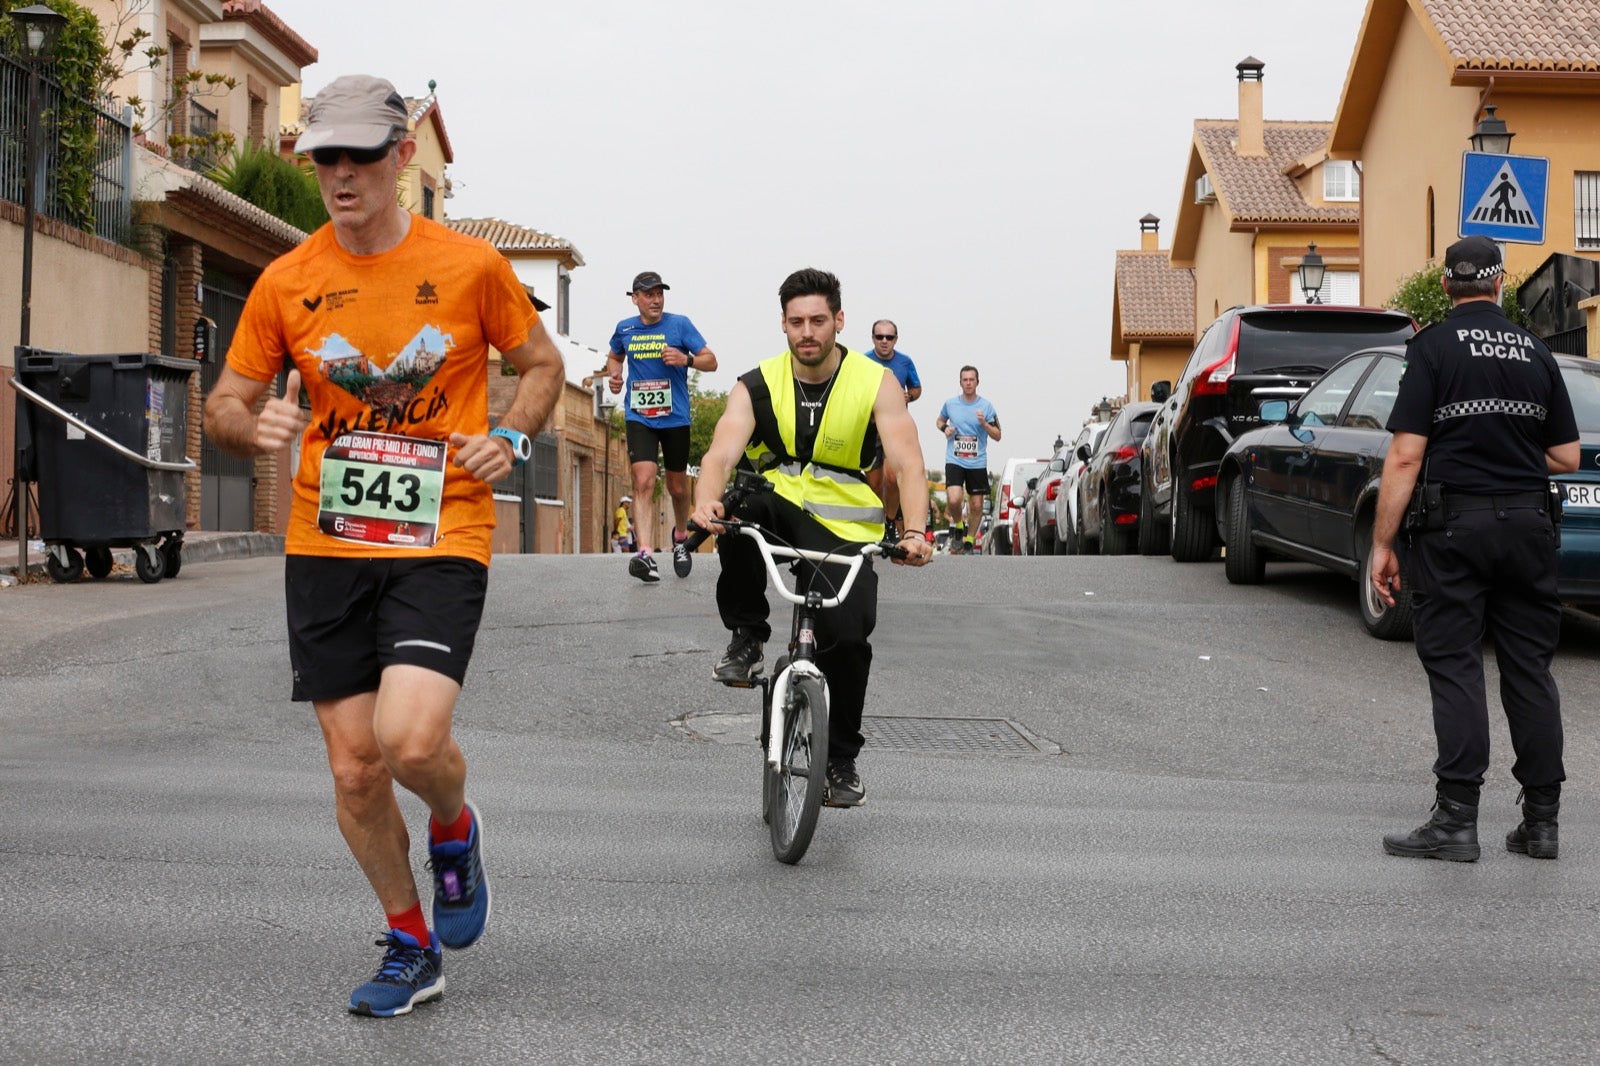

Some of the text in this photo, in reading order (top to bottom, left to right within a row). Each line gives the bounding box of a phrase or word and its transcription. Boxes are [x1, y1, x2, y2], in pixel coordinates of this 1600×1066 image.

[1456, 328, 1535, 350] POLICIA
[1469, 342, 1531, 362] LOCAL
[638, 391, 665, 406] 323
[351, 436, 373, 450] GRAN
[372, 438, 400, 454] PREMIO
[401, 442, 412, 456] DE
[412, 443, 439, 459] FONDO
[956, 441, 977, 451] 3009
[340, 467, 420, 512] 543
[1568, 486, 1589, 504] GR
